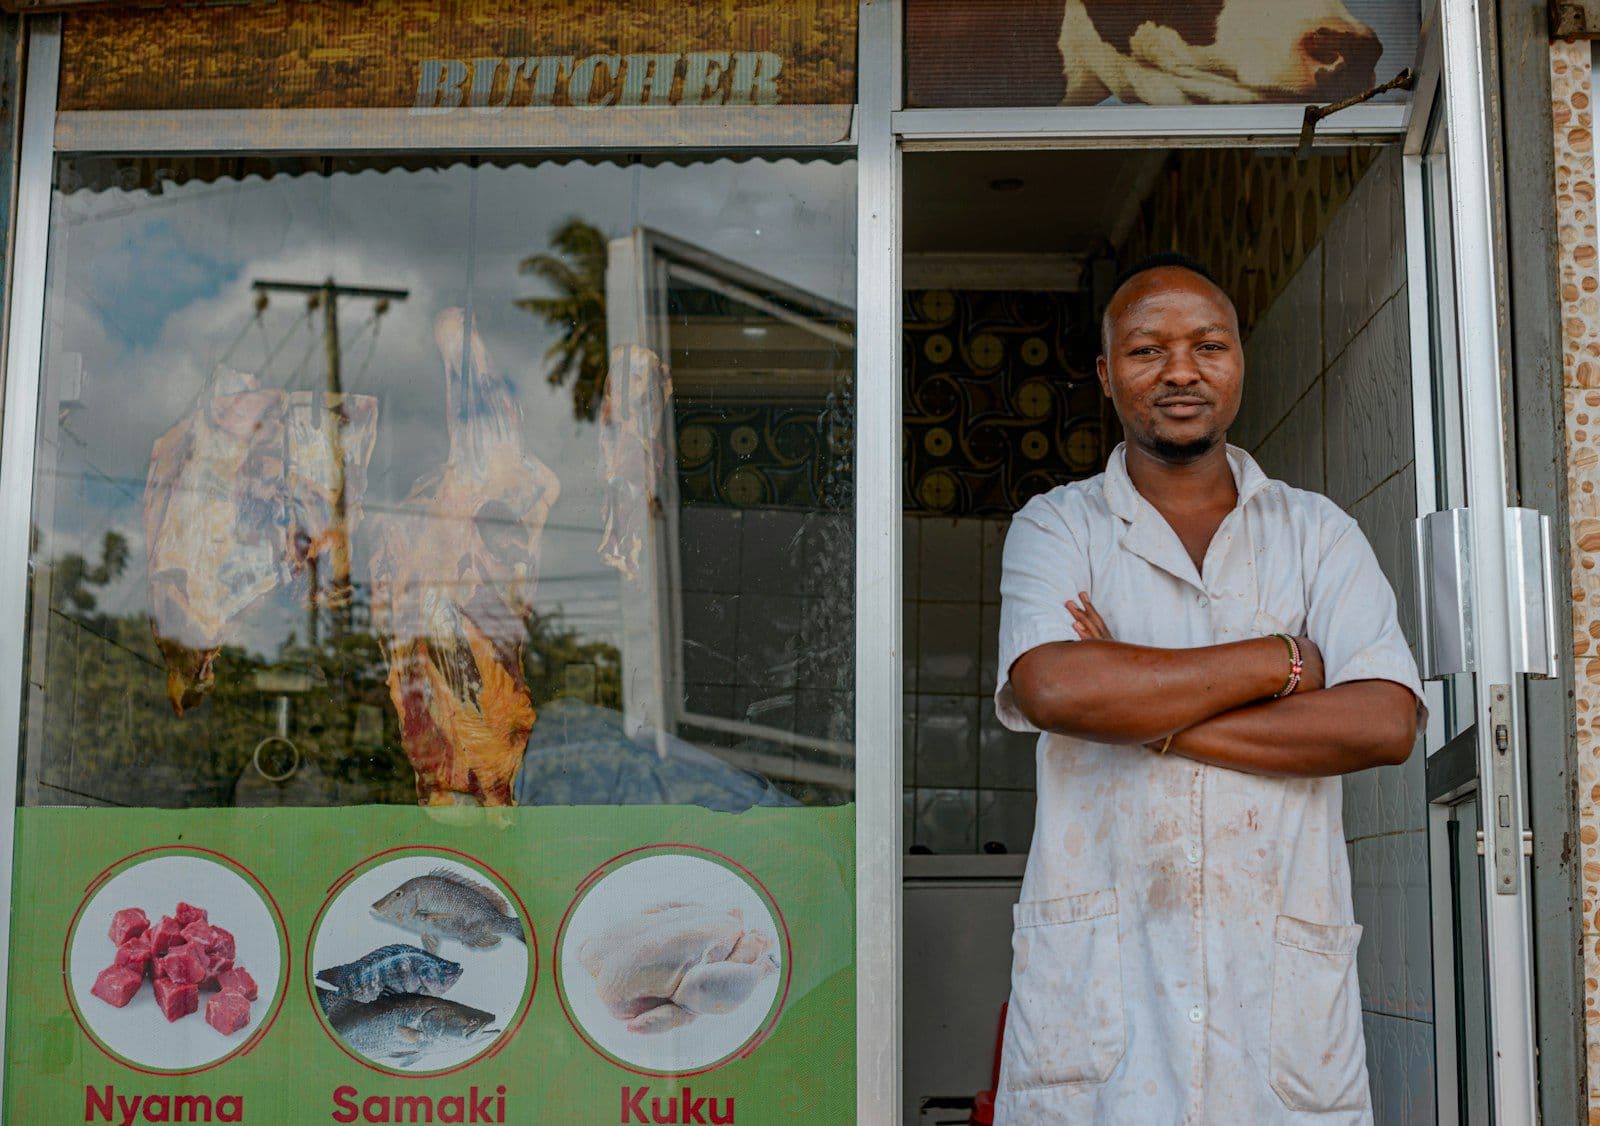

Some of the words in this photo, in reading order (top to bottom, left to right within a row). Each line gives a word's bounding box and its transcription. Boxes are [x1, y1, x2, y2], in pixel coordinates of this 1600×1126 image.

[409, 51, 783, 115] BUTCHER
[85, 1085, 243, 1126] Nyama
[331, 1085, 506, 1124] Samaki
[620, 1086, 735, 1125] Kuku
